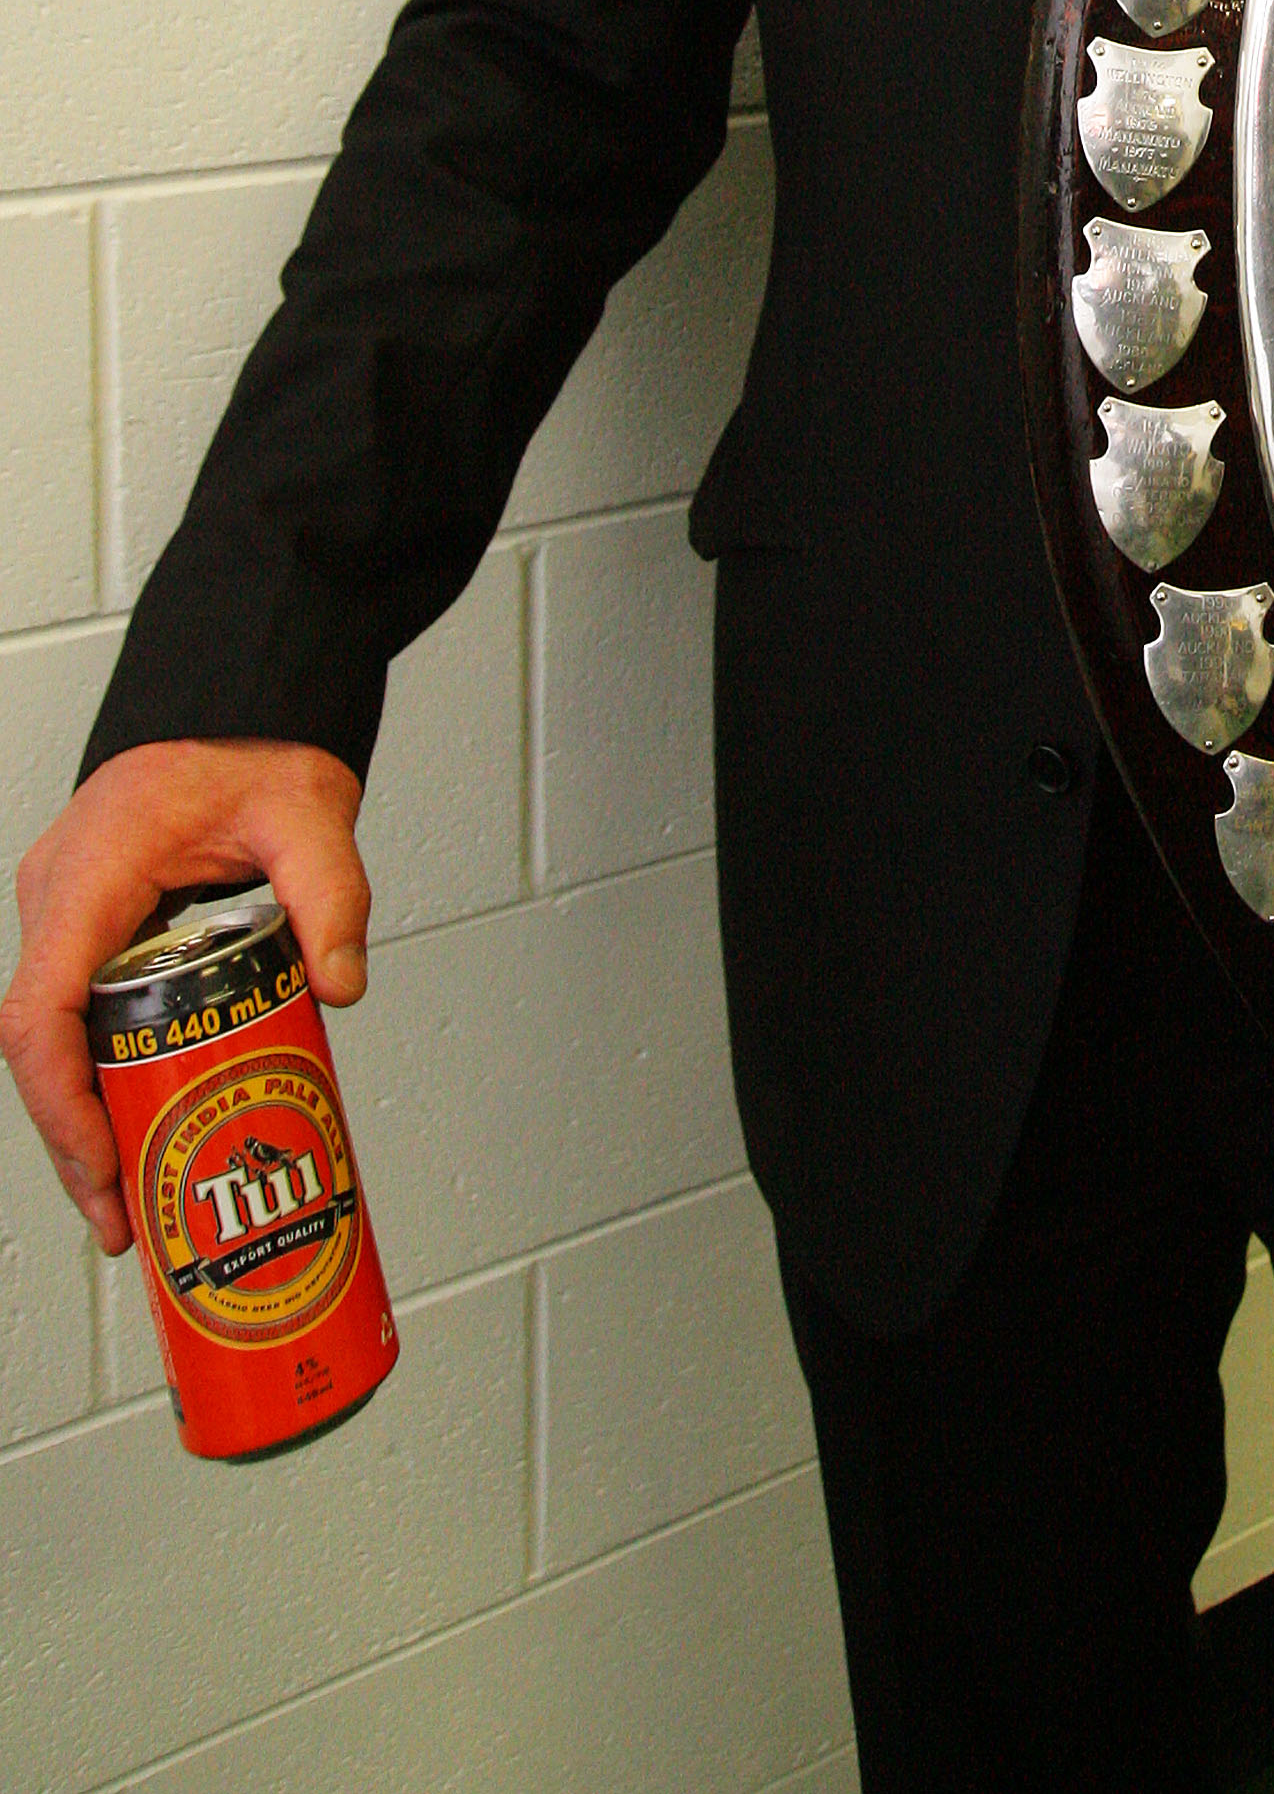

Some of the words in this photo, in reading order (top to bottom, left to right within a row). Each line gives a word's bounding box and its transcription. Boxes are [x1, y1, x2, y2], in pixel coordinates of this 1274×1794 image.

[1097, 126, 1182, 148] MANAWATU
[1097, 156, 1179, 179] MANAWATU
[1101, 288, 1181, 310] AUCKLAND
[112, 1028, 158, 1061] BIG
[166, 1007, 220, 1046] 440
[230, 986, 272, 1024] mL
[160, 1163, 179, 1238] EAST
[174, 1087, 251, 1154] INDIA
[265, 1078, 319, 1110] PALE
[322, 1114, 344, 1163] ALE
[192, 1149, 325, 1245] Tui
[223, 1241, 274, 1275] EXPORT
[276, 1218, 326, 1248] QUALITY
